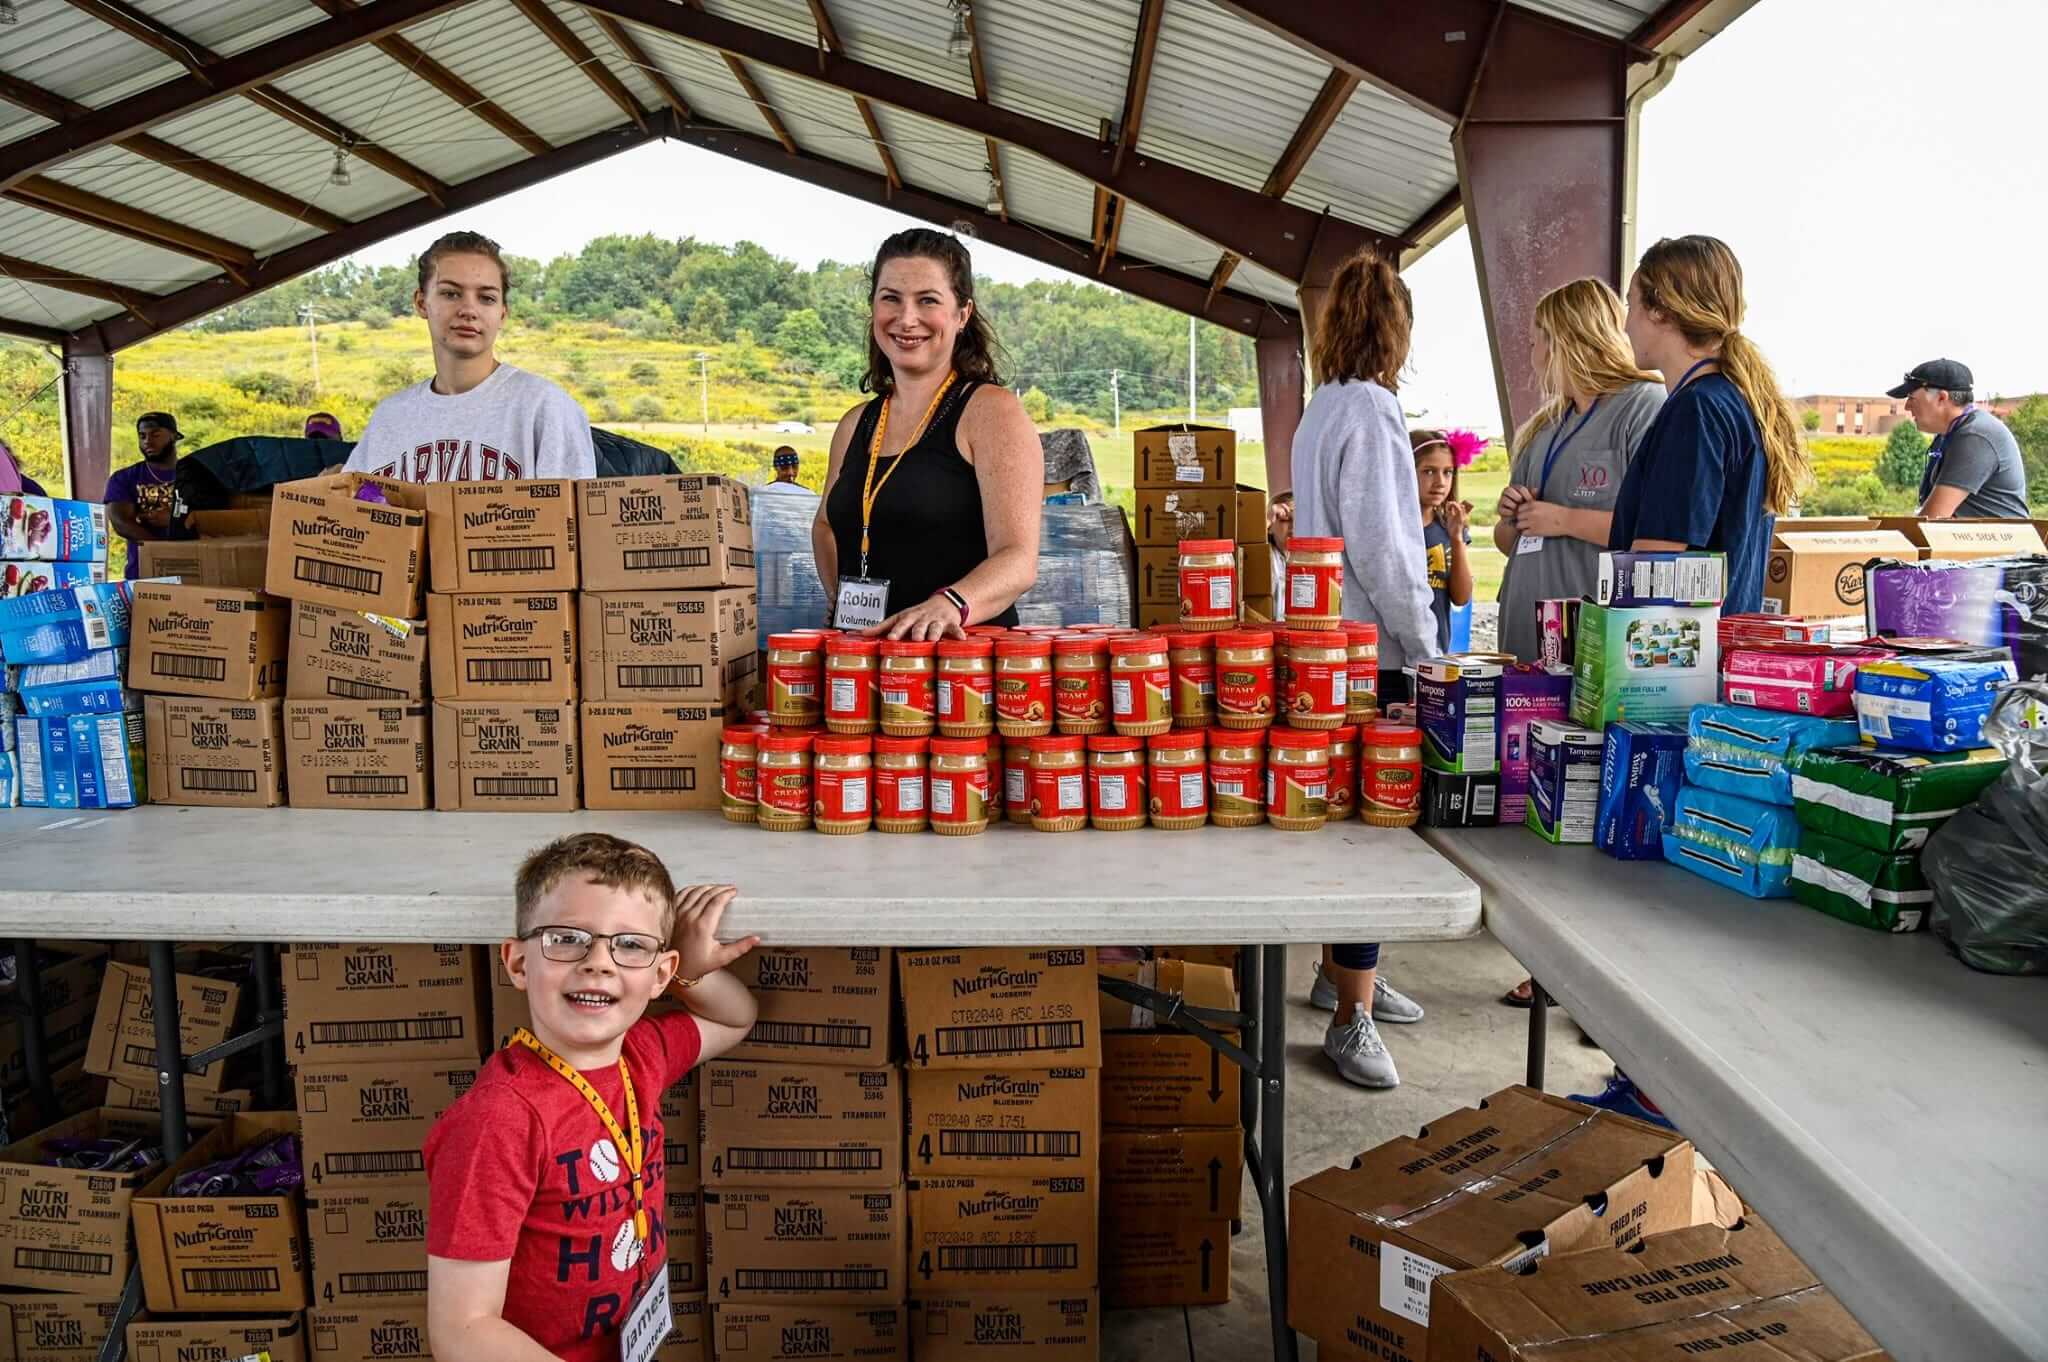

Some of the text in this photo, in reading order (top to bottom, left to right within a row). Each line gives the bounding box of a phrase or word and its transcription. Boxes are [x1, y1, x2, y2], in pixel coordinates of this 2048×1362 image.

[532, 485, 559, 497] 35745
[619, 496, 661, 513] NUTRI
[372, 510, 400, 526] 35745
[620, 508, 663, 523] GRAIN
[1952, 532, 2014, 542] THIS SIDE UP
[530, 599, 556, 609] 35745
[843, 590, 881, 609] Robin
[678, 602, 704, 613] 35645
[630, 618, 672, 633] NUTRI
[331, 626, 369, 643] NUTRI
[630, 632, 673, 643] GRAIN
[330, 640, 369, 656] GRAIN
[1418, 681, 1446, 697] Tampons
[1505, 696, 1532, 708] 100%
[679, 709, 705, 720] 35745
[192, 722, 227, 736] NUTRI
[324, 724, 363, 738] NUTRI
[479, 725, 519, 738] NUTRI
[192, 736, 229, 746] GRAIN
[325, 738, 365, 748] GRAIN
[479, 738, 520, 750] GRAIN
[344, 955, 393, 972] NUTRI
[759, 956, 808, 972] NUTRI
[1050, 951, 1083, 965] 35745
[345, 972, 394, 986] GRAIN
[418, 978, 464, 988] STRAWBERRY
[758, 972, 808, 986] GRAIN
[832, 986, 878, 995] STRAWBERRY
[295, 1031, 306, 1054] 4
[914, 1034, 930, 1066] 4
[360, 1088, 408, 1104] NUTRI
[768, 1086, 817, 1101] NUTRI
[361, 1103, 411, 1117] GRAIN
[768, 1100, 817, 1114] GRAIN
[842, 1112, 886, 1120] STRAWBERRY
[918, 1134, 933, 1164] 4
[312, 1162, 322, 1184] 4
[712, 1156, 724, 1178] 4
[1051, 1179, 1083, 1191] 35745
[20, 1188, 69, 1205] NUTRI
[19, 1203, 68, 1220] GRAIN
[78, 1209, 120, 1220] STRAWBERRY
[247, 1205, 278, 1217] 35745
[375, 1209, 422, 1226] NUTRI
[775, 1208, 822, 1224] NUTRI
[1611, 1201, 1648, 1236] FRIED PIES
[375, 1224, 425, 1239] GRAIN
[774, 1223, 823, 1236] GRAIN
[847, 1232, 890, 1241] STRAWBERRY
[1614, 1223, 1642, 1249] HANDLE
[918, 1251, 933, 1280] 4
[1582, 1254, 1741, 1297] HANDLE WITH CARE
[323, 1282, 335, 1303] 4
[720, 1277, 730, 1298] 4
[1636, 1275, 1730, 1304] FRIED PIES
[34, 1319, 81, 1336] NUTRI
[625, 1285, 665, 1360] James
[974, 1314, 1021, 1329] NUTRI
[370, 1327, 418, 1343] NUTRI
[782, 1327, 829, 1343] NUTRI
[974, 1328, 1021, 1341] GRAIN
[1356, 1314, 1406, 1348] HANDLE
[1675, 1321, 1788, 1354] THIS SIDE UP
[35, 1333, 83, 1346] GRAIN
[1346, 1328, 1379, 1355] WITH
[177, 1347, 227, 1362] NUTRI
[371, 1341, 421, 1355] GRAIN
[782, 1342, 830, 1355] GRAIN
